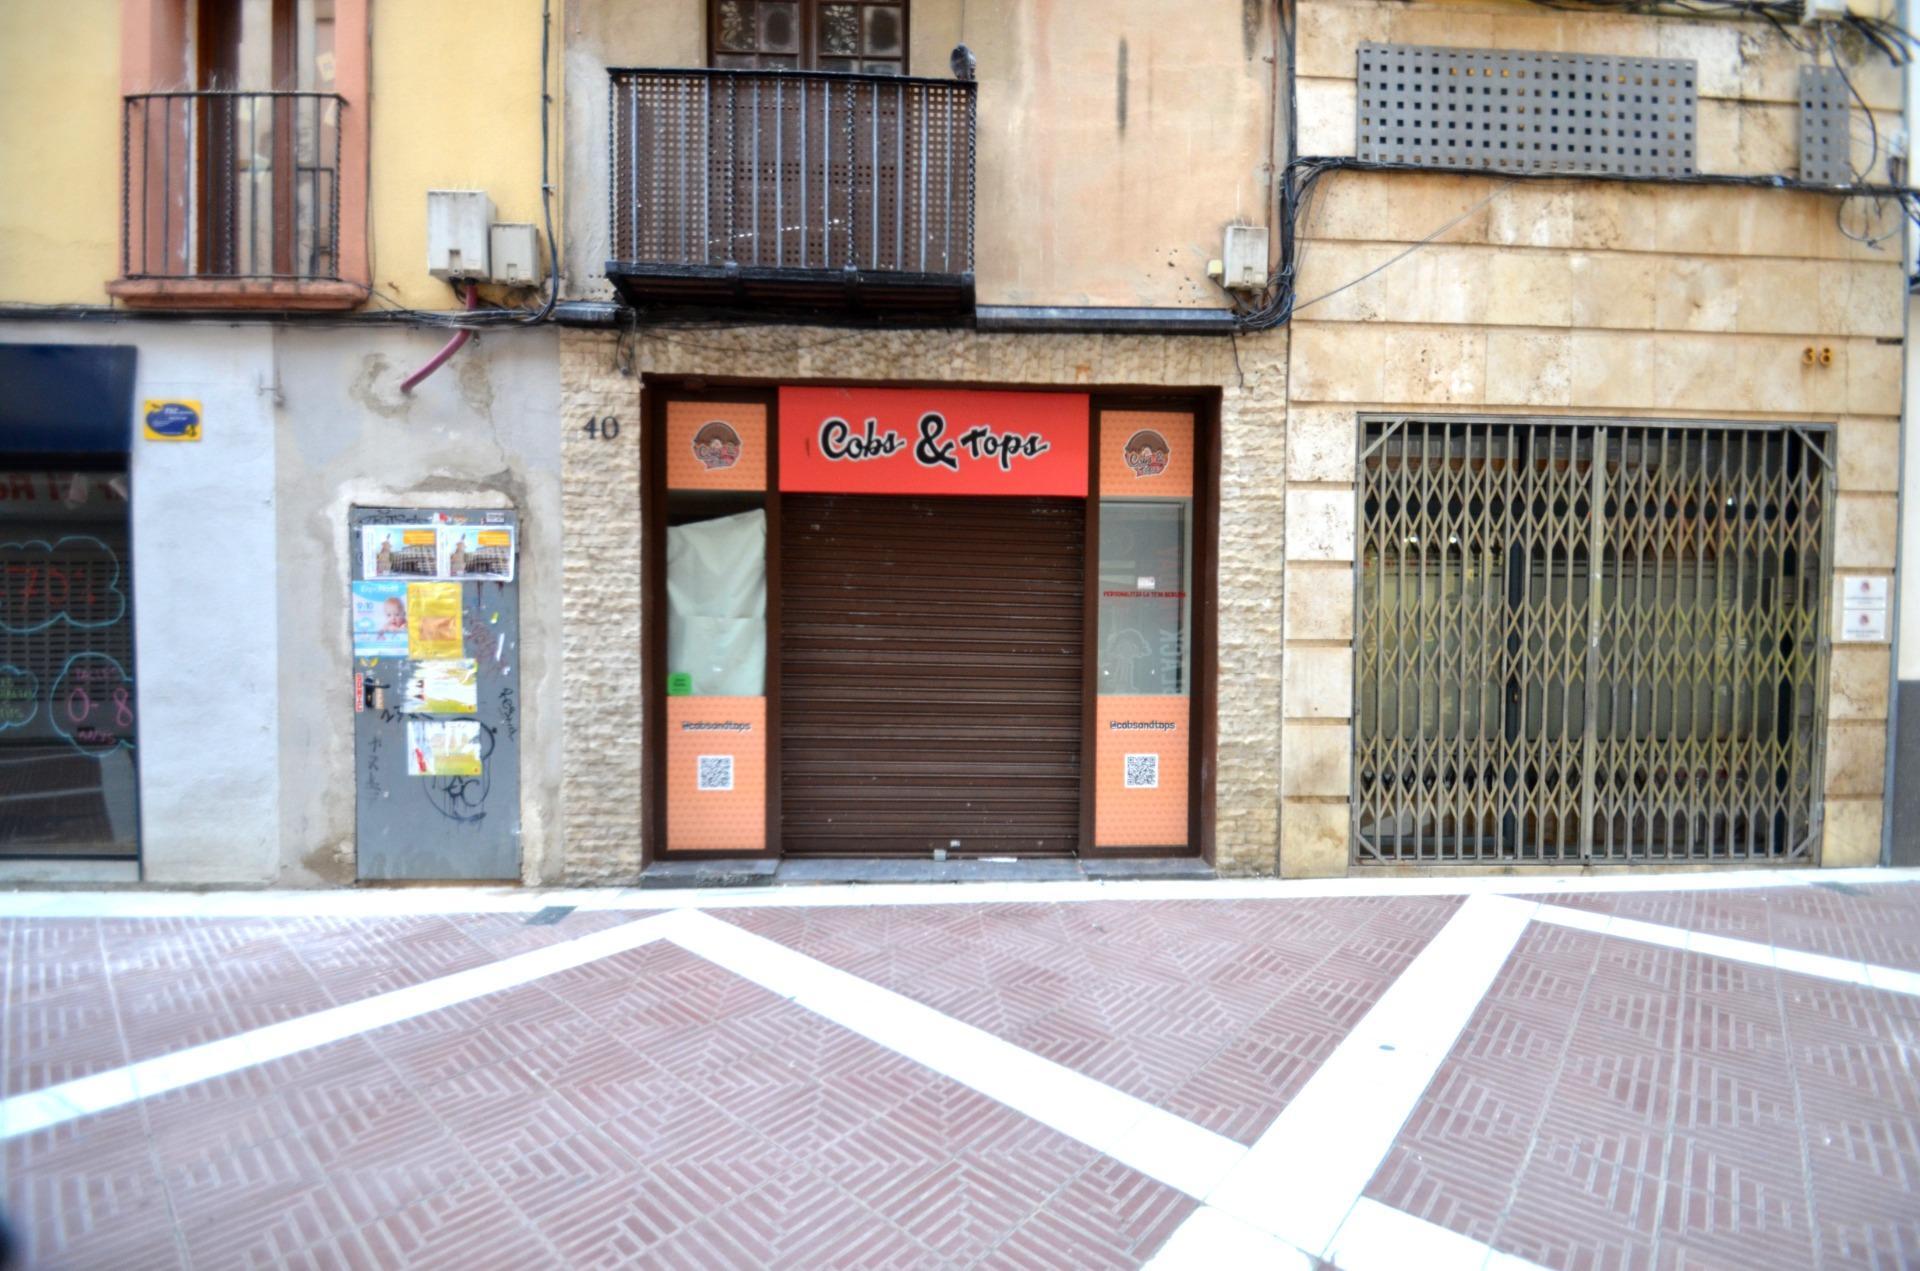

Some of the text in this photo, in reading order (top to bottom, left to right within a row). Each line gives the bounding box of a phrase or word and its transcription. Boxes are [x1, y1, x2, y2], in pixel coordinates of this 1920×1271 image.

[1801, 345, 1833, 367] 38
[582, 415, 620, 441] 40
[819, 411, 1050, 471] Cobs & Tops
